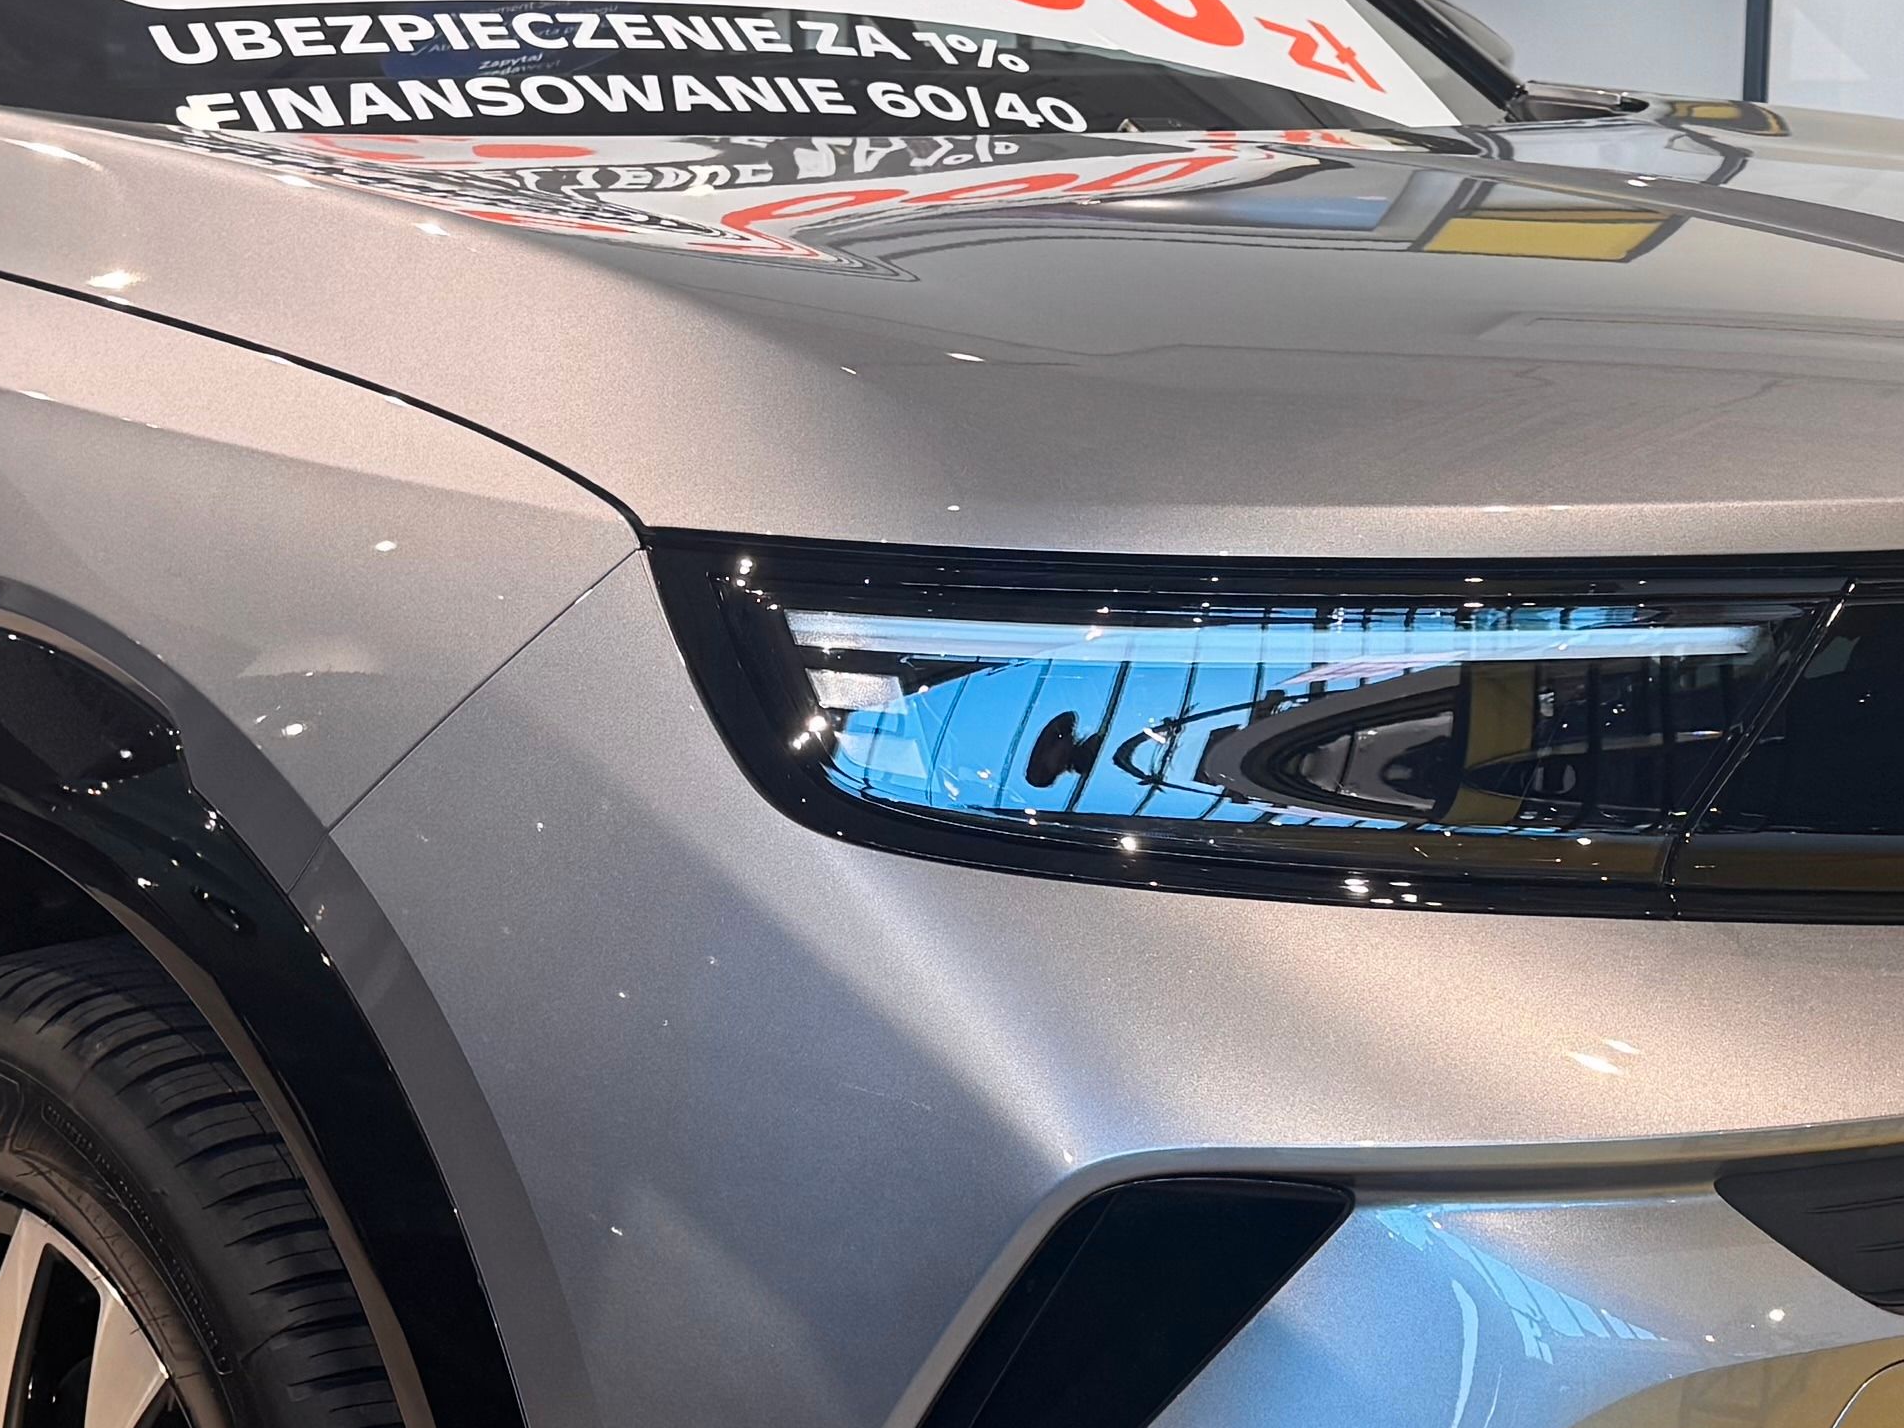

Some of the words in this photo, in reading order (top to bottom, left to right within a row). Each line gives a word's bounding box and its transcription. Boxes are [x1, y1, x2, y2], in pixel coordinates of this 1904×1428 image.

[148, 12, 793, 66] UBEZPIECZENIE
[796, 20, 912, 61] ZA
[911, 31, 1030, 73] 1%
[1254, 18, 1387, 94] zł
[179, 74, 857, 133] FINANSOWANIE
[866, 80, 1088, 133] 60/40
